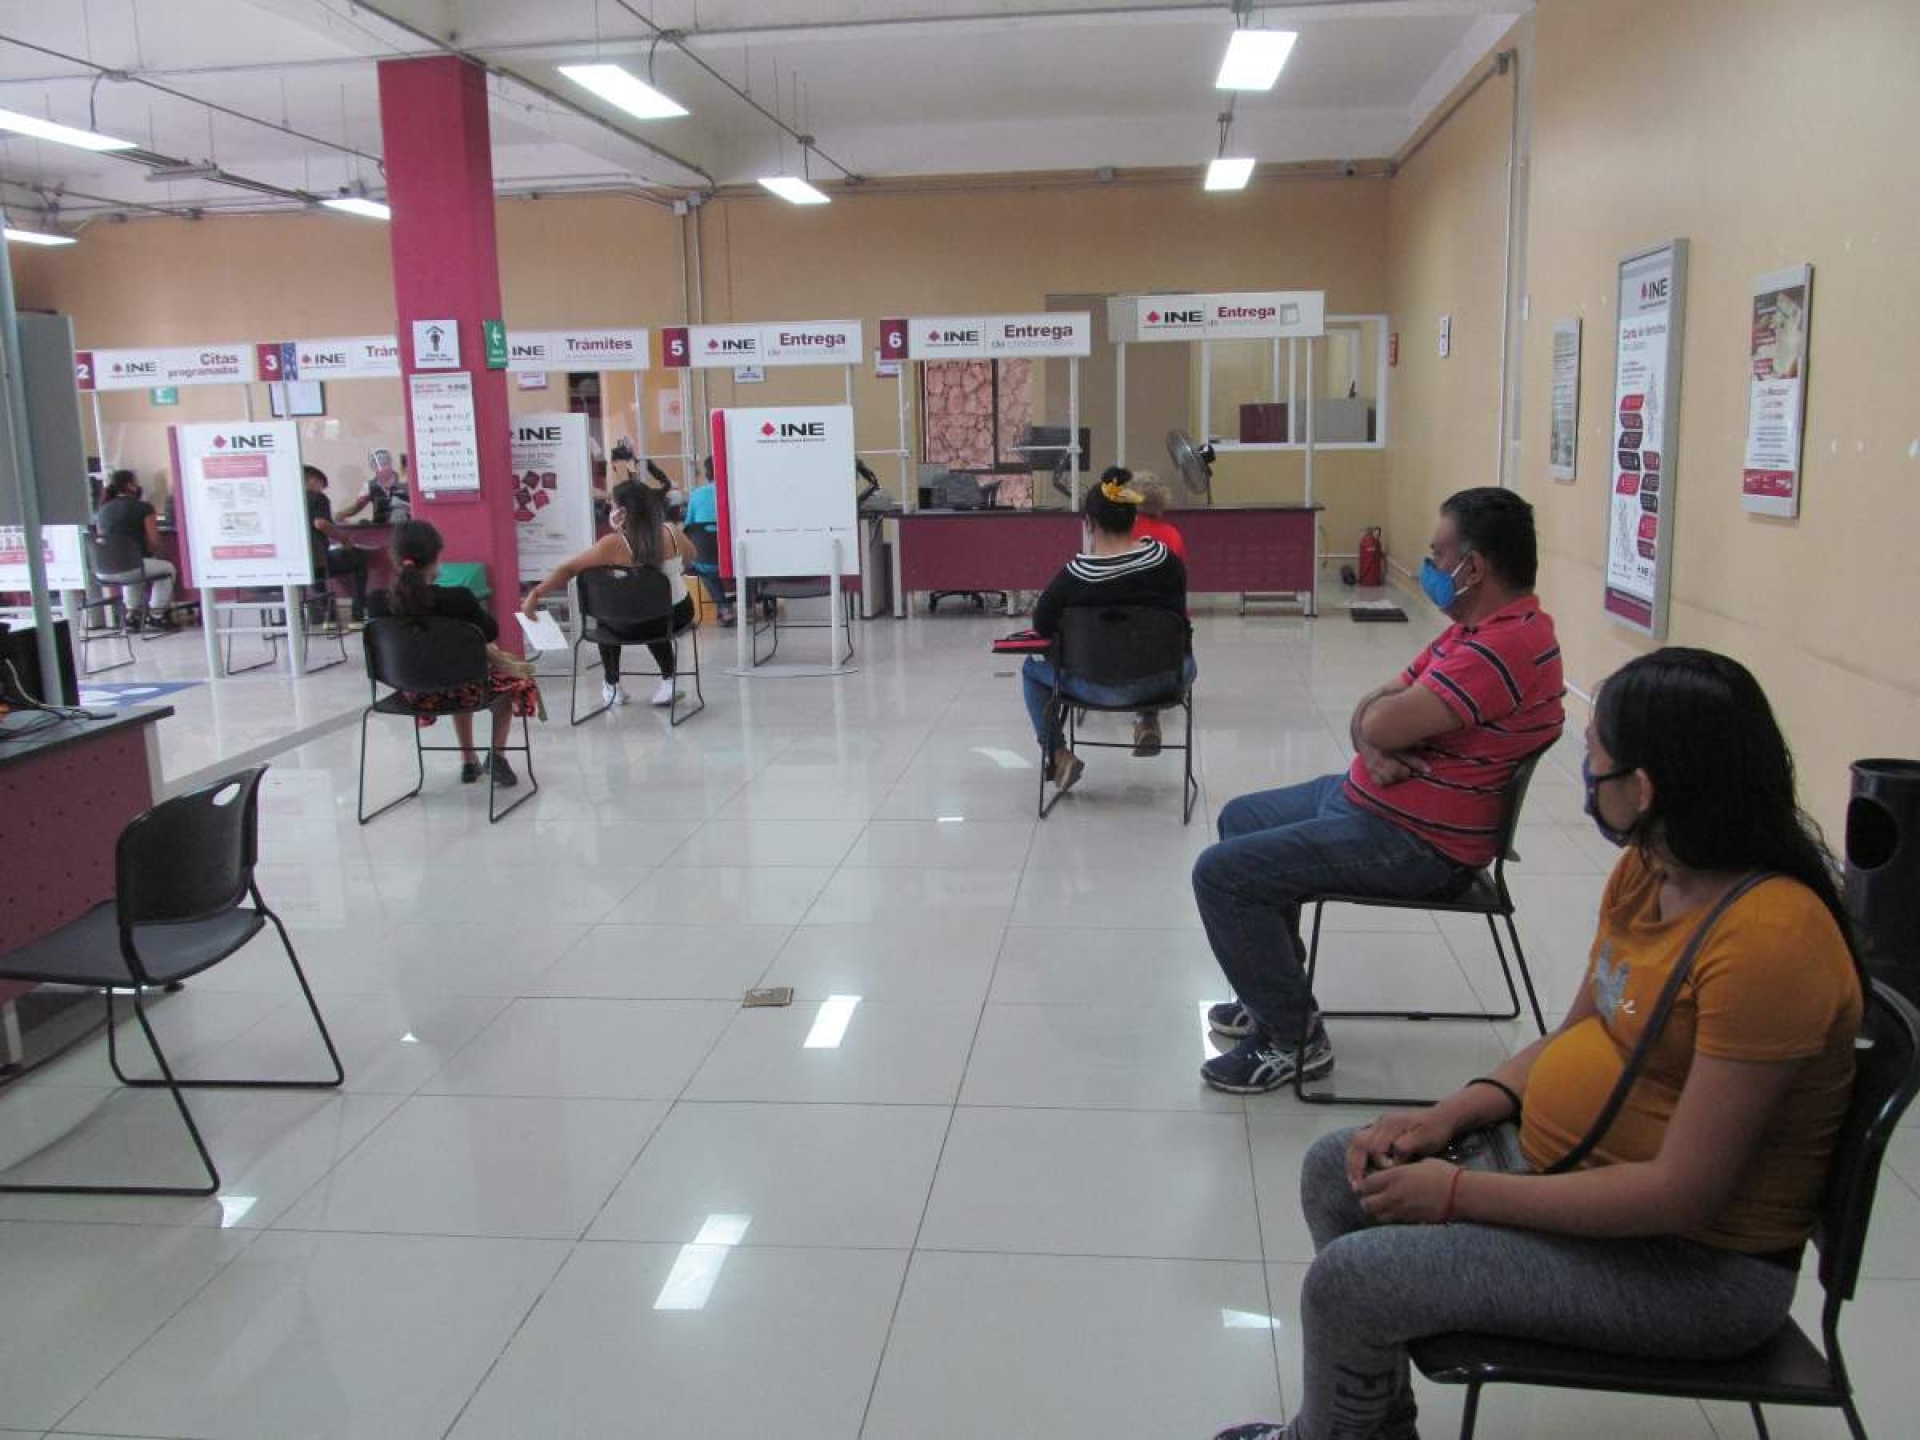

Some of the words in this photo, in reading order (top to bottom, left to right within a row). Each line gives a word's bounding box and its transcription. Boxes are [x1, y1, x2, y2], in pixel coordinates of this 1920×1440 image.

[1649, 277, 1667, 299] INE
[1164, 311, 1203, 323] INE
[1218, 306, 1275, 319] Entrega
[780, 332, 846, 348] Entrega
[889, 332, 902, 347] 6
[943, 330, 979, 342] INE
[1004, 324, 1073, 340] Entrega
[512, 345, 545, 356] INE
[565, 336, 633, 351] Trámites
[671, 339, 684, 356] 5
[722, 338, 756, 350] INE
[200, 353, 238, 366] Citas
[265, 354, 278, 371] 3
[315, 353, 346, 364] INE
[76, 364, 90, 379] 2
[125, 361, 156, 372] INE
[168, 366, 239, 379] programadas
[519, 426, 562, 441] INE
[780, 422, 825, 437] INE
[231, 434, 275, 449] INE
